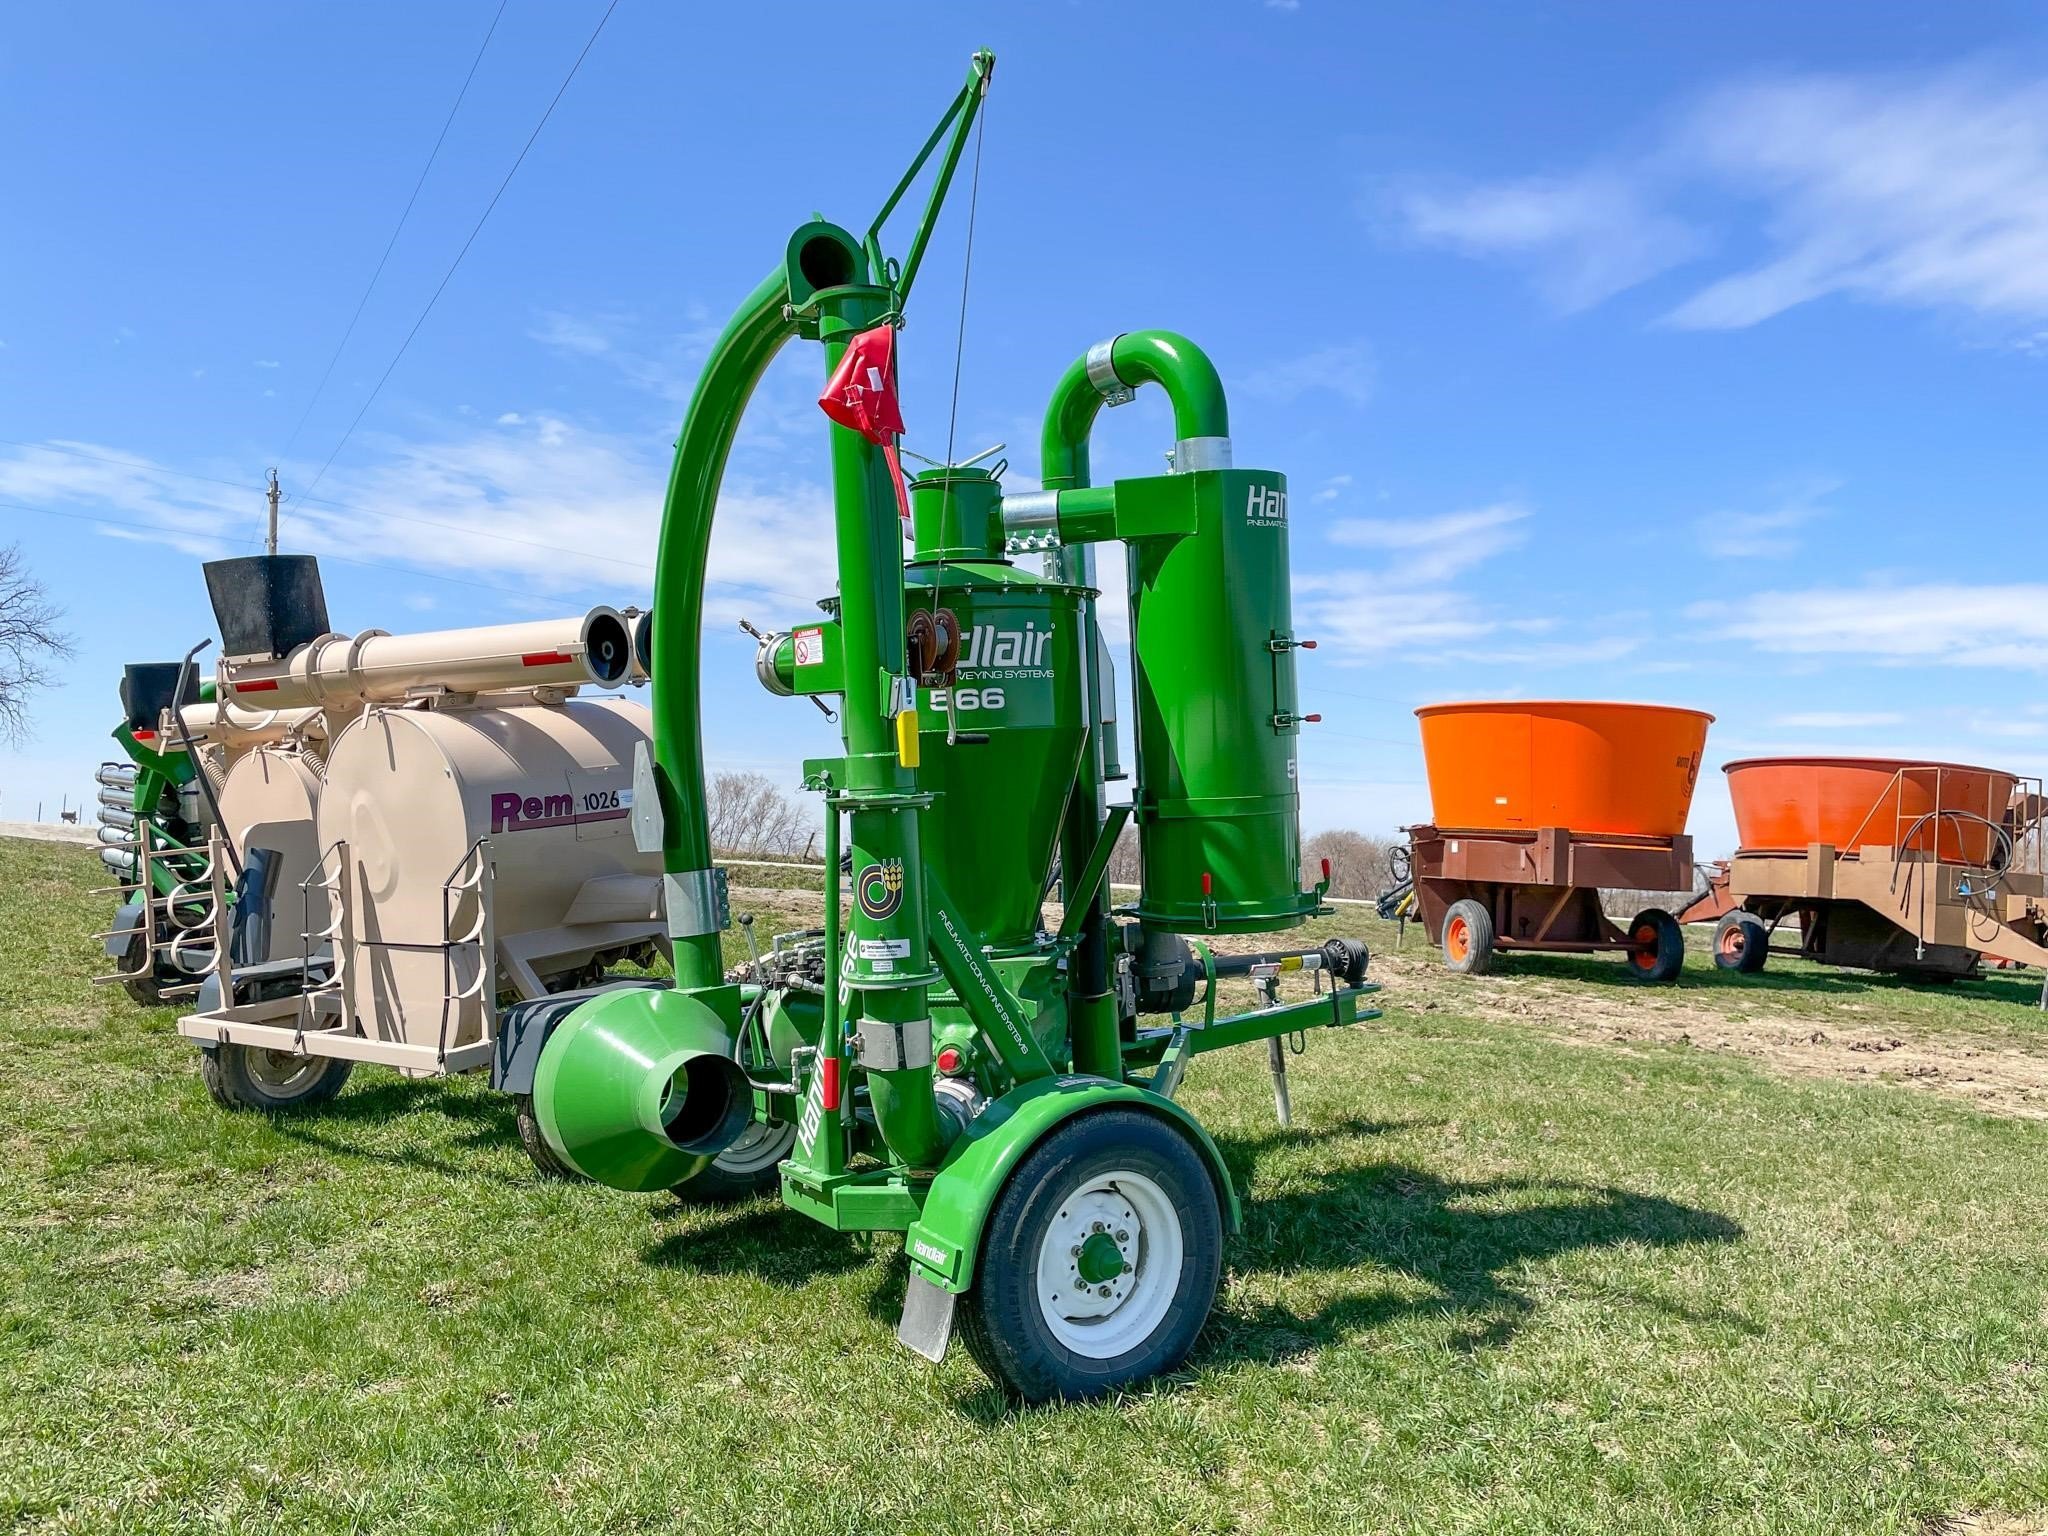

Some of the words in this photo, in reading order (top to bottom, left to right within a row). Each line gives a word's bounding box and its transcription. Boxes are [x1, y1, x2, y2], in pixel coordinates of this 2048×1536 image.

[1246, 484, 1288, 519] Han
[957, 621, 1053, 668] dllair
[958, 669, 1002, 680] VEYING
[1004, 669, 1055, 679] SYSTEMS
[929, 688, 1005, 711] 566
[491, 792, 574, 834] Rem
[582, 790, 620, 811] 1026
[937, 909, 973, 963] PNEUMATIC
[970, 961, 1004, 1014] CONVEYING
[1001, 1011, 1028, 1055] SYSTEMS
[913, 1238, 947, 1266] Handlair
